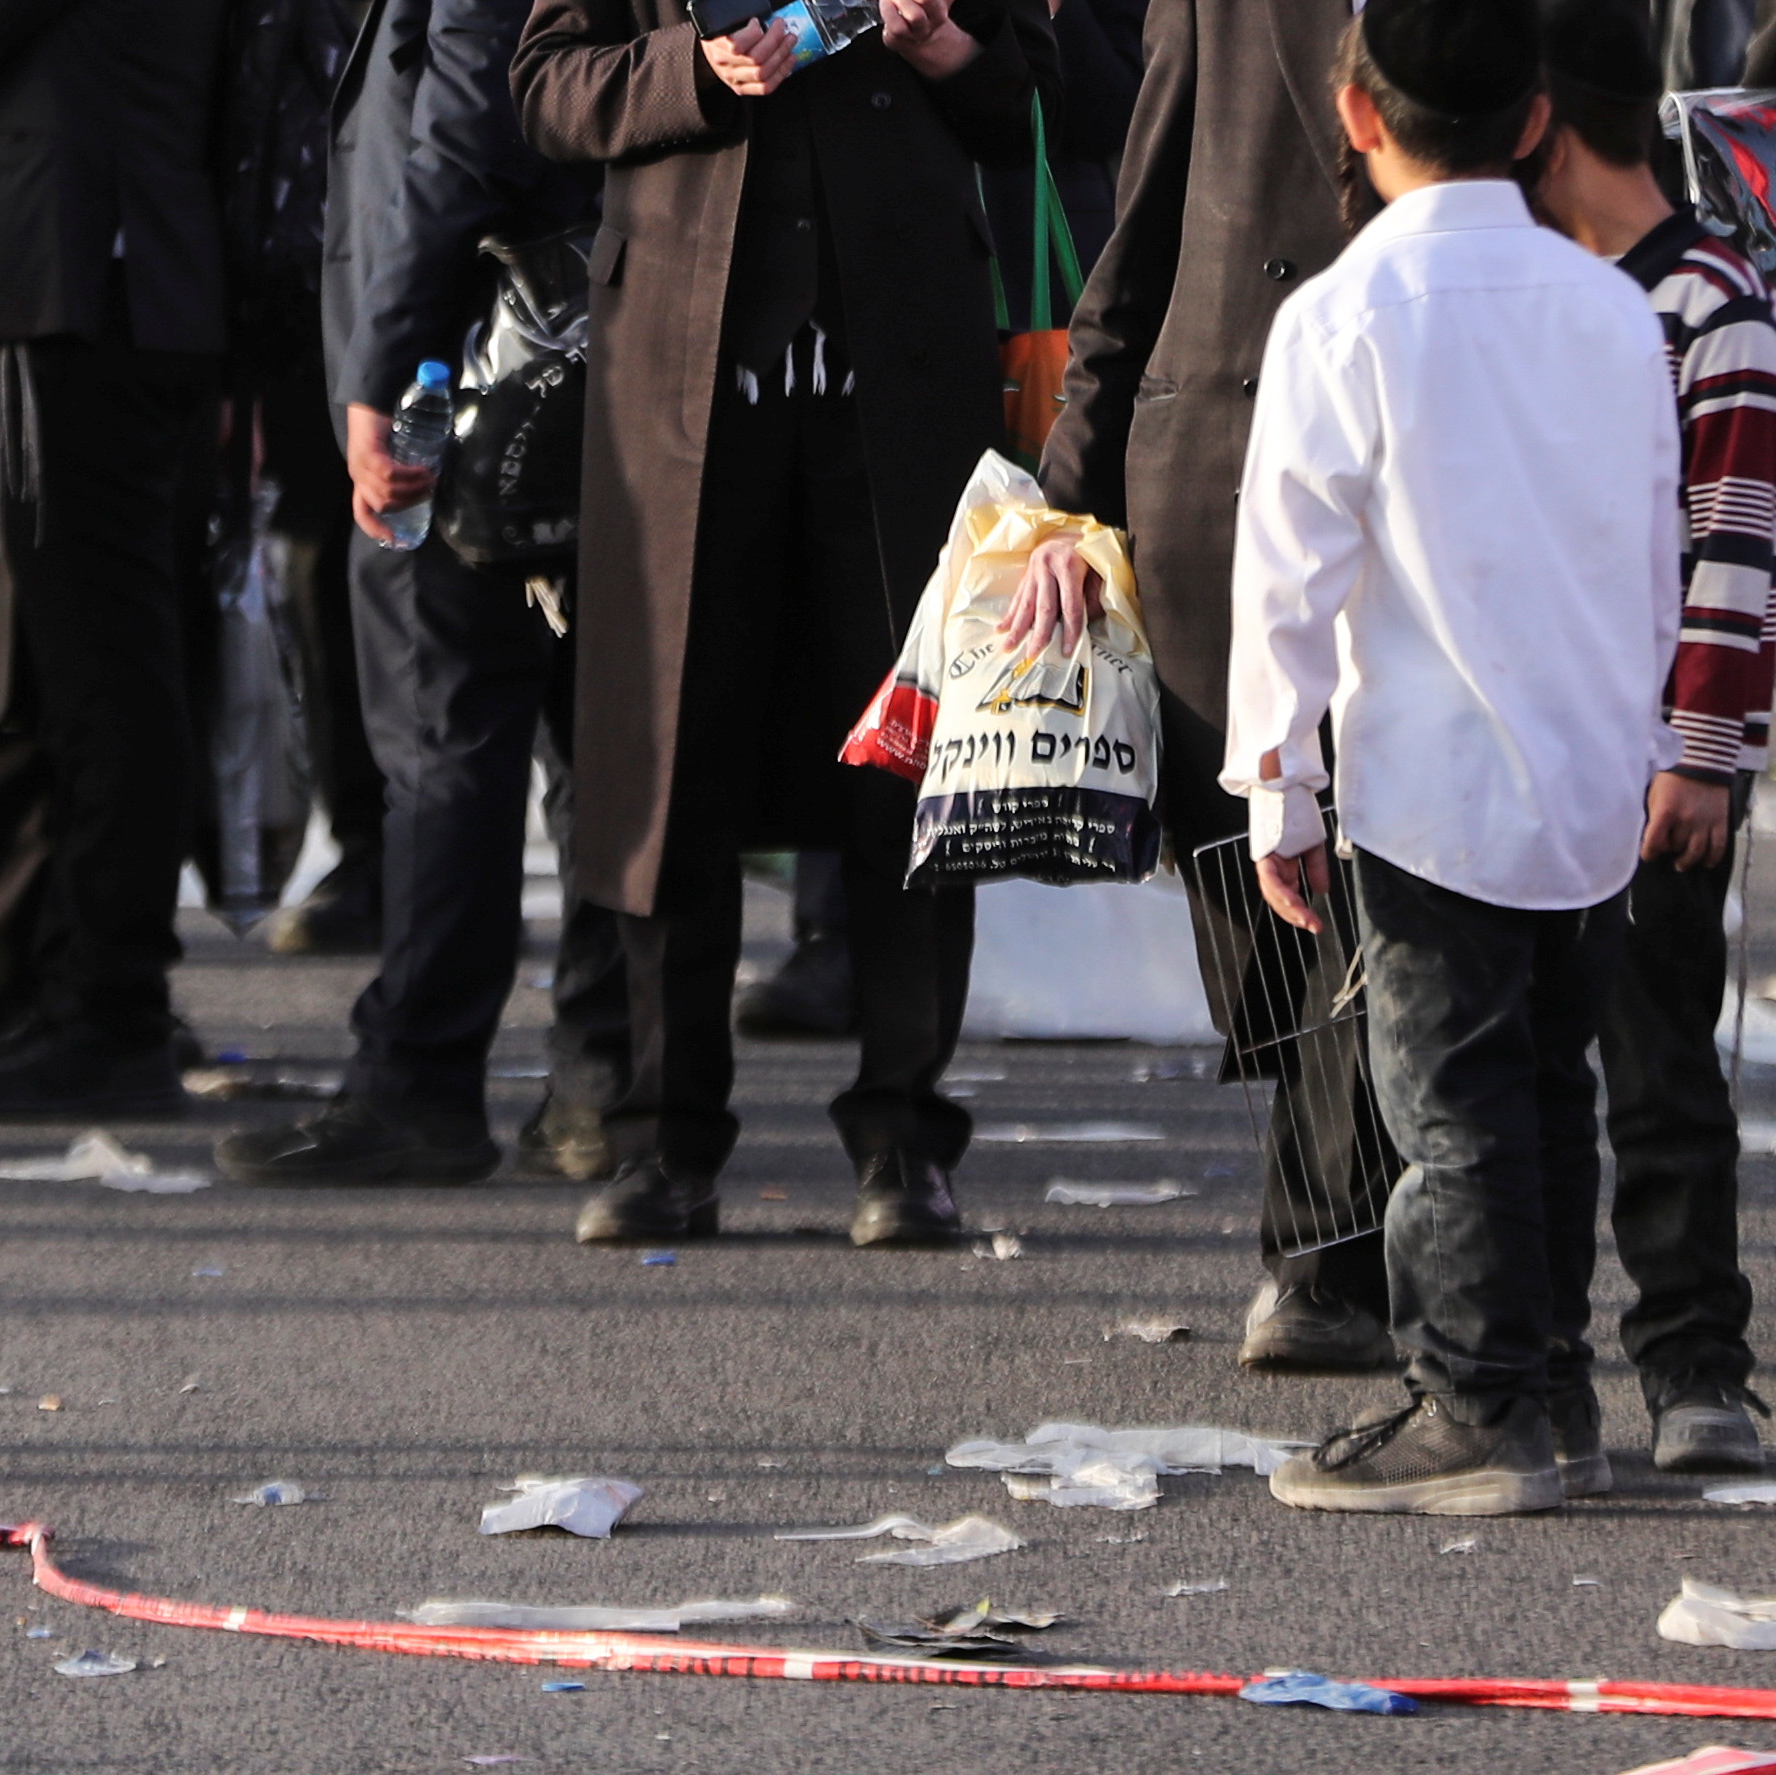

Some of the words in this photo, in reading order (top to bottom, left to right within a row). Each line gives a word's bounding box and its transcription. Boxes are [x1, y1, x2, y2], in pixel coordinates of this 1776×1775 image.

[949, 642, 995, 680] The
[1031, 729, 1136, 775] ספרים
[991, 800, 1019, 814] קודש
[1022, 798, 1049, 809] ספרי
[1087, 821, 1115, 834] ספרי
